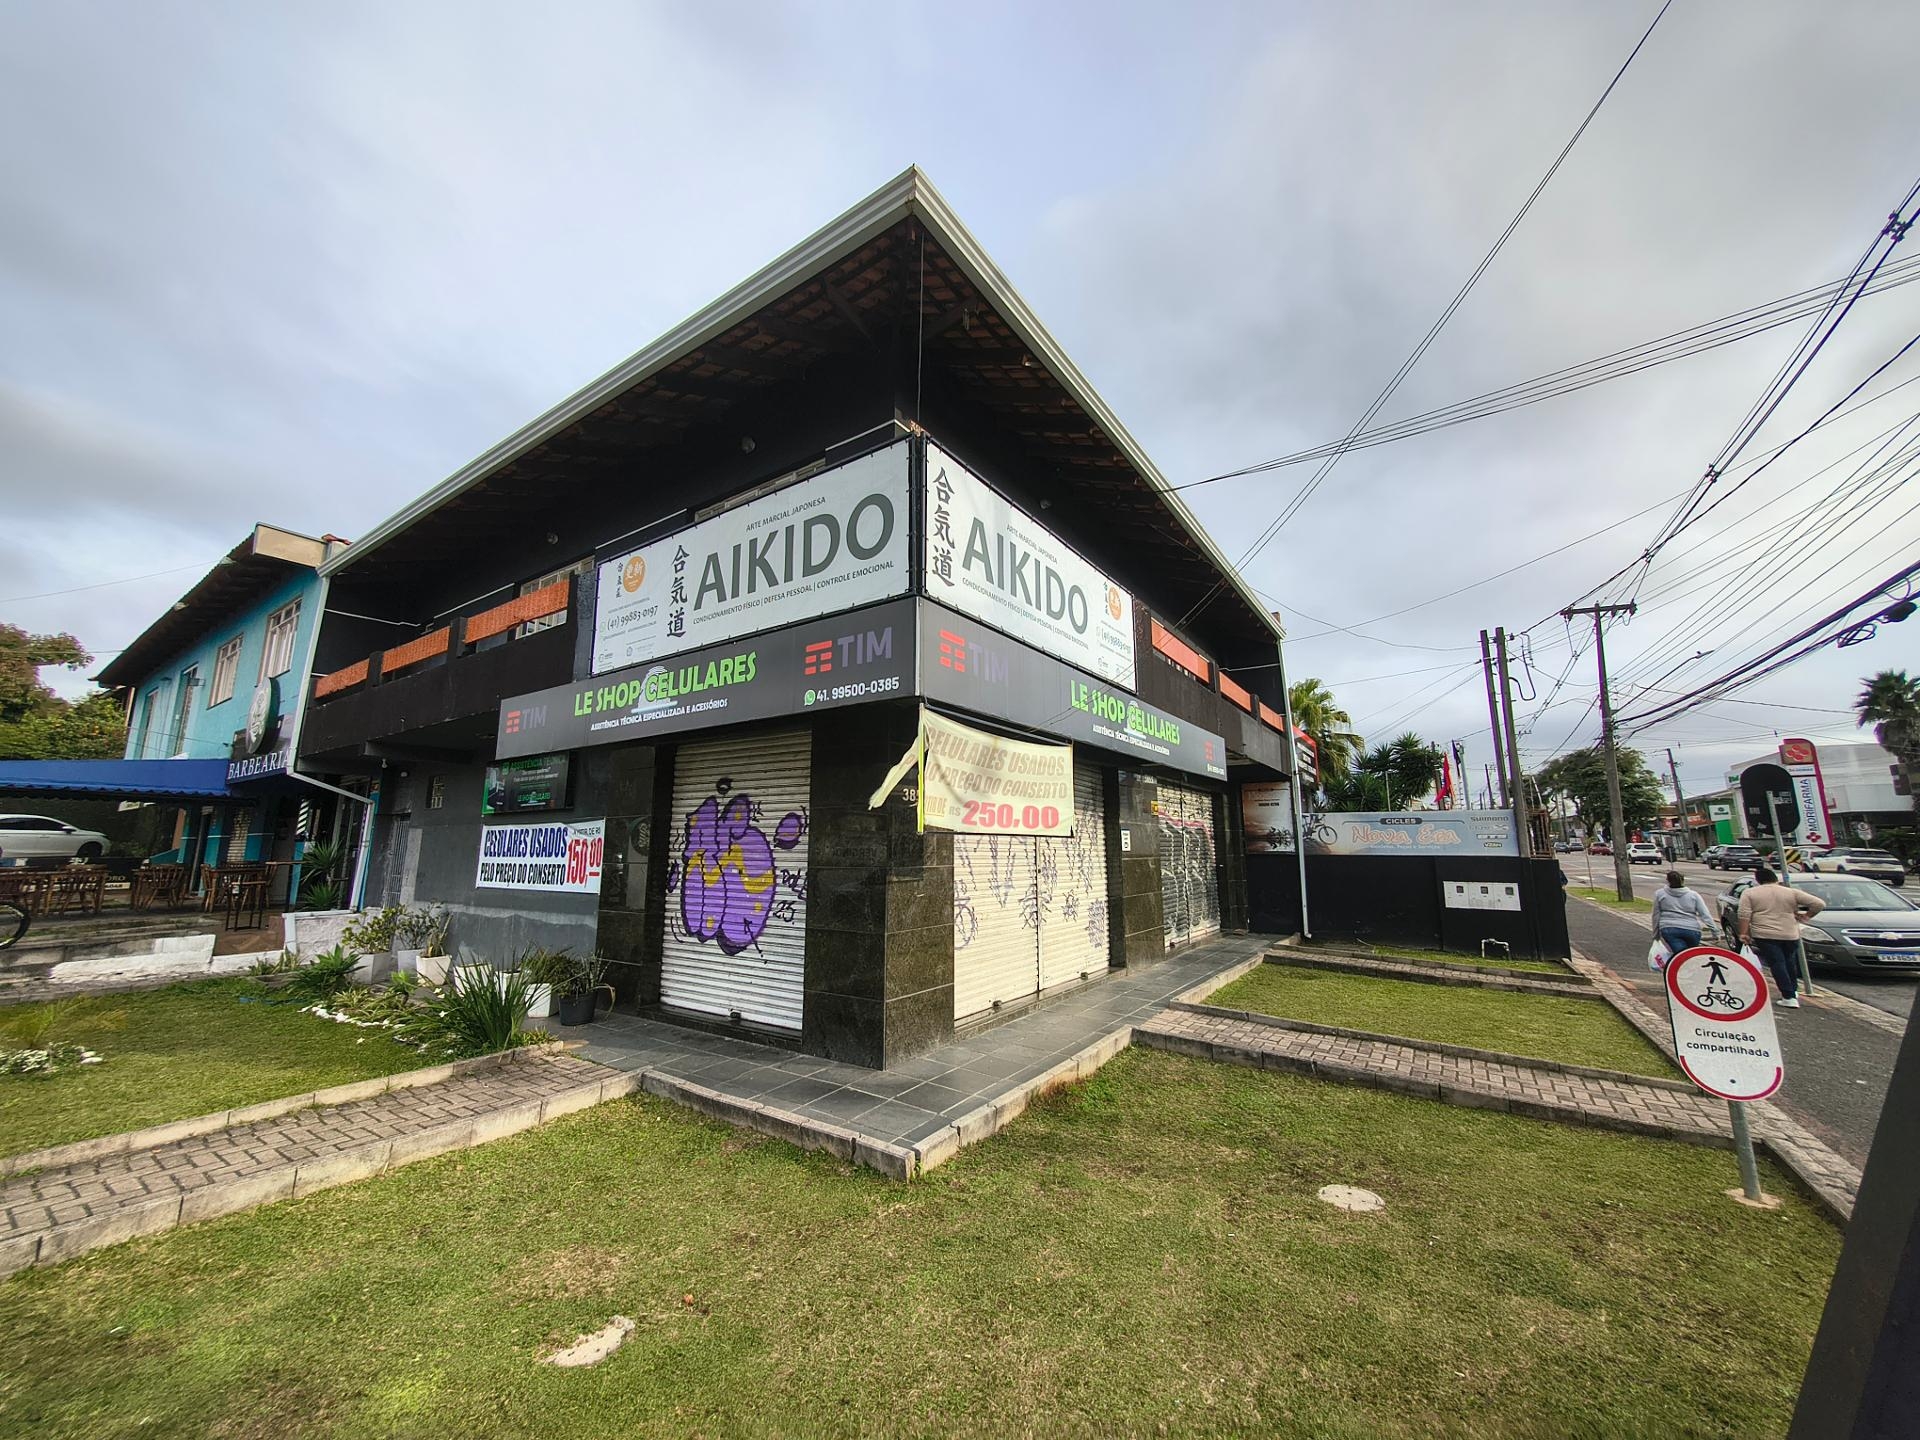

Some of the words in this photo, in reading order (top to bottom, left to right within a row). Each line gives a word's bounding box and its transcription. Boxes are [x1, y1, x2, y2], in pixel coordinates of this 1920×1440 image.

[746, 520, 761, 532] ARTE
[763, 511, 790, 526] MARCIAL
[791, 497, 826, 516] JAPONESA
[932, 466, 955, 586] 合気道
[693, 493, 895, 611] AIKIDO
[667, 545, 690, 638] 合気道
[693, 605, 742, 624] CONDICIONAMENTO
[743, 599, 760, 611] FÍSICO
[764, 592, 785, 605] DEFESA
[786, 584, 812, 598] PESSOAL
[817, 573, 850, 589] CONTROLE
[852, 560, 894, 579] EMOCIONAL
[962, 517, 1088, 635] AIKIDO
[837, 626, 892, 668] TIM
[968, 642, 1008, 686] TIM
[574, 690, 593, 716] LE
[596, 679, 641, 712] SHOP
[645, 651, 757, 702] CELULARES
[832, 677, 899, 699] 99500-0385
[522, 705, 547, 729] TIM
[620, 714, 642, 726] TÉCNICA
[643, 707, 685, 722] ESPECIALIZADA
[686, 706, 691, 714] E
[691, 698, 728, 712] ACESSÓRIOS
[1071, 679, 1088, 712] LE
[1092, 689, 1125, 724] SHOP
[1127, 706, 1180, 746] CELULARES
[227, 748, 290, 779] BARBEARIA
[928, 727, 1008, 771] CELULARES
[1008, 752, 1064, 776] USADOS
[903, 789, 918, 801] 38
[939, 766, 983, 794] PREÇO
[984, 775, 1002, 796] DO
[1002, 779, 1067, 799] CONSERTO
[1801, 778, 1818, 832] MORIFARMA
[484, 827, 528, 858] CELULARES
[529, 826, 568, 858] USADOS
[1352, 824, 1412, 844] Nova
[1417, 823, 1461, 844] Era
[480, 862, 495, 882] PELO
[495, 863, 516, 887] PREÇO
[517, 864, 527, 884] DO
[528, 863, 566, 886] CONSERTO
[1686, 1042, 1770, 1057] compartilhada
[1695, 1028, 1756, 1042] Circulação
